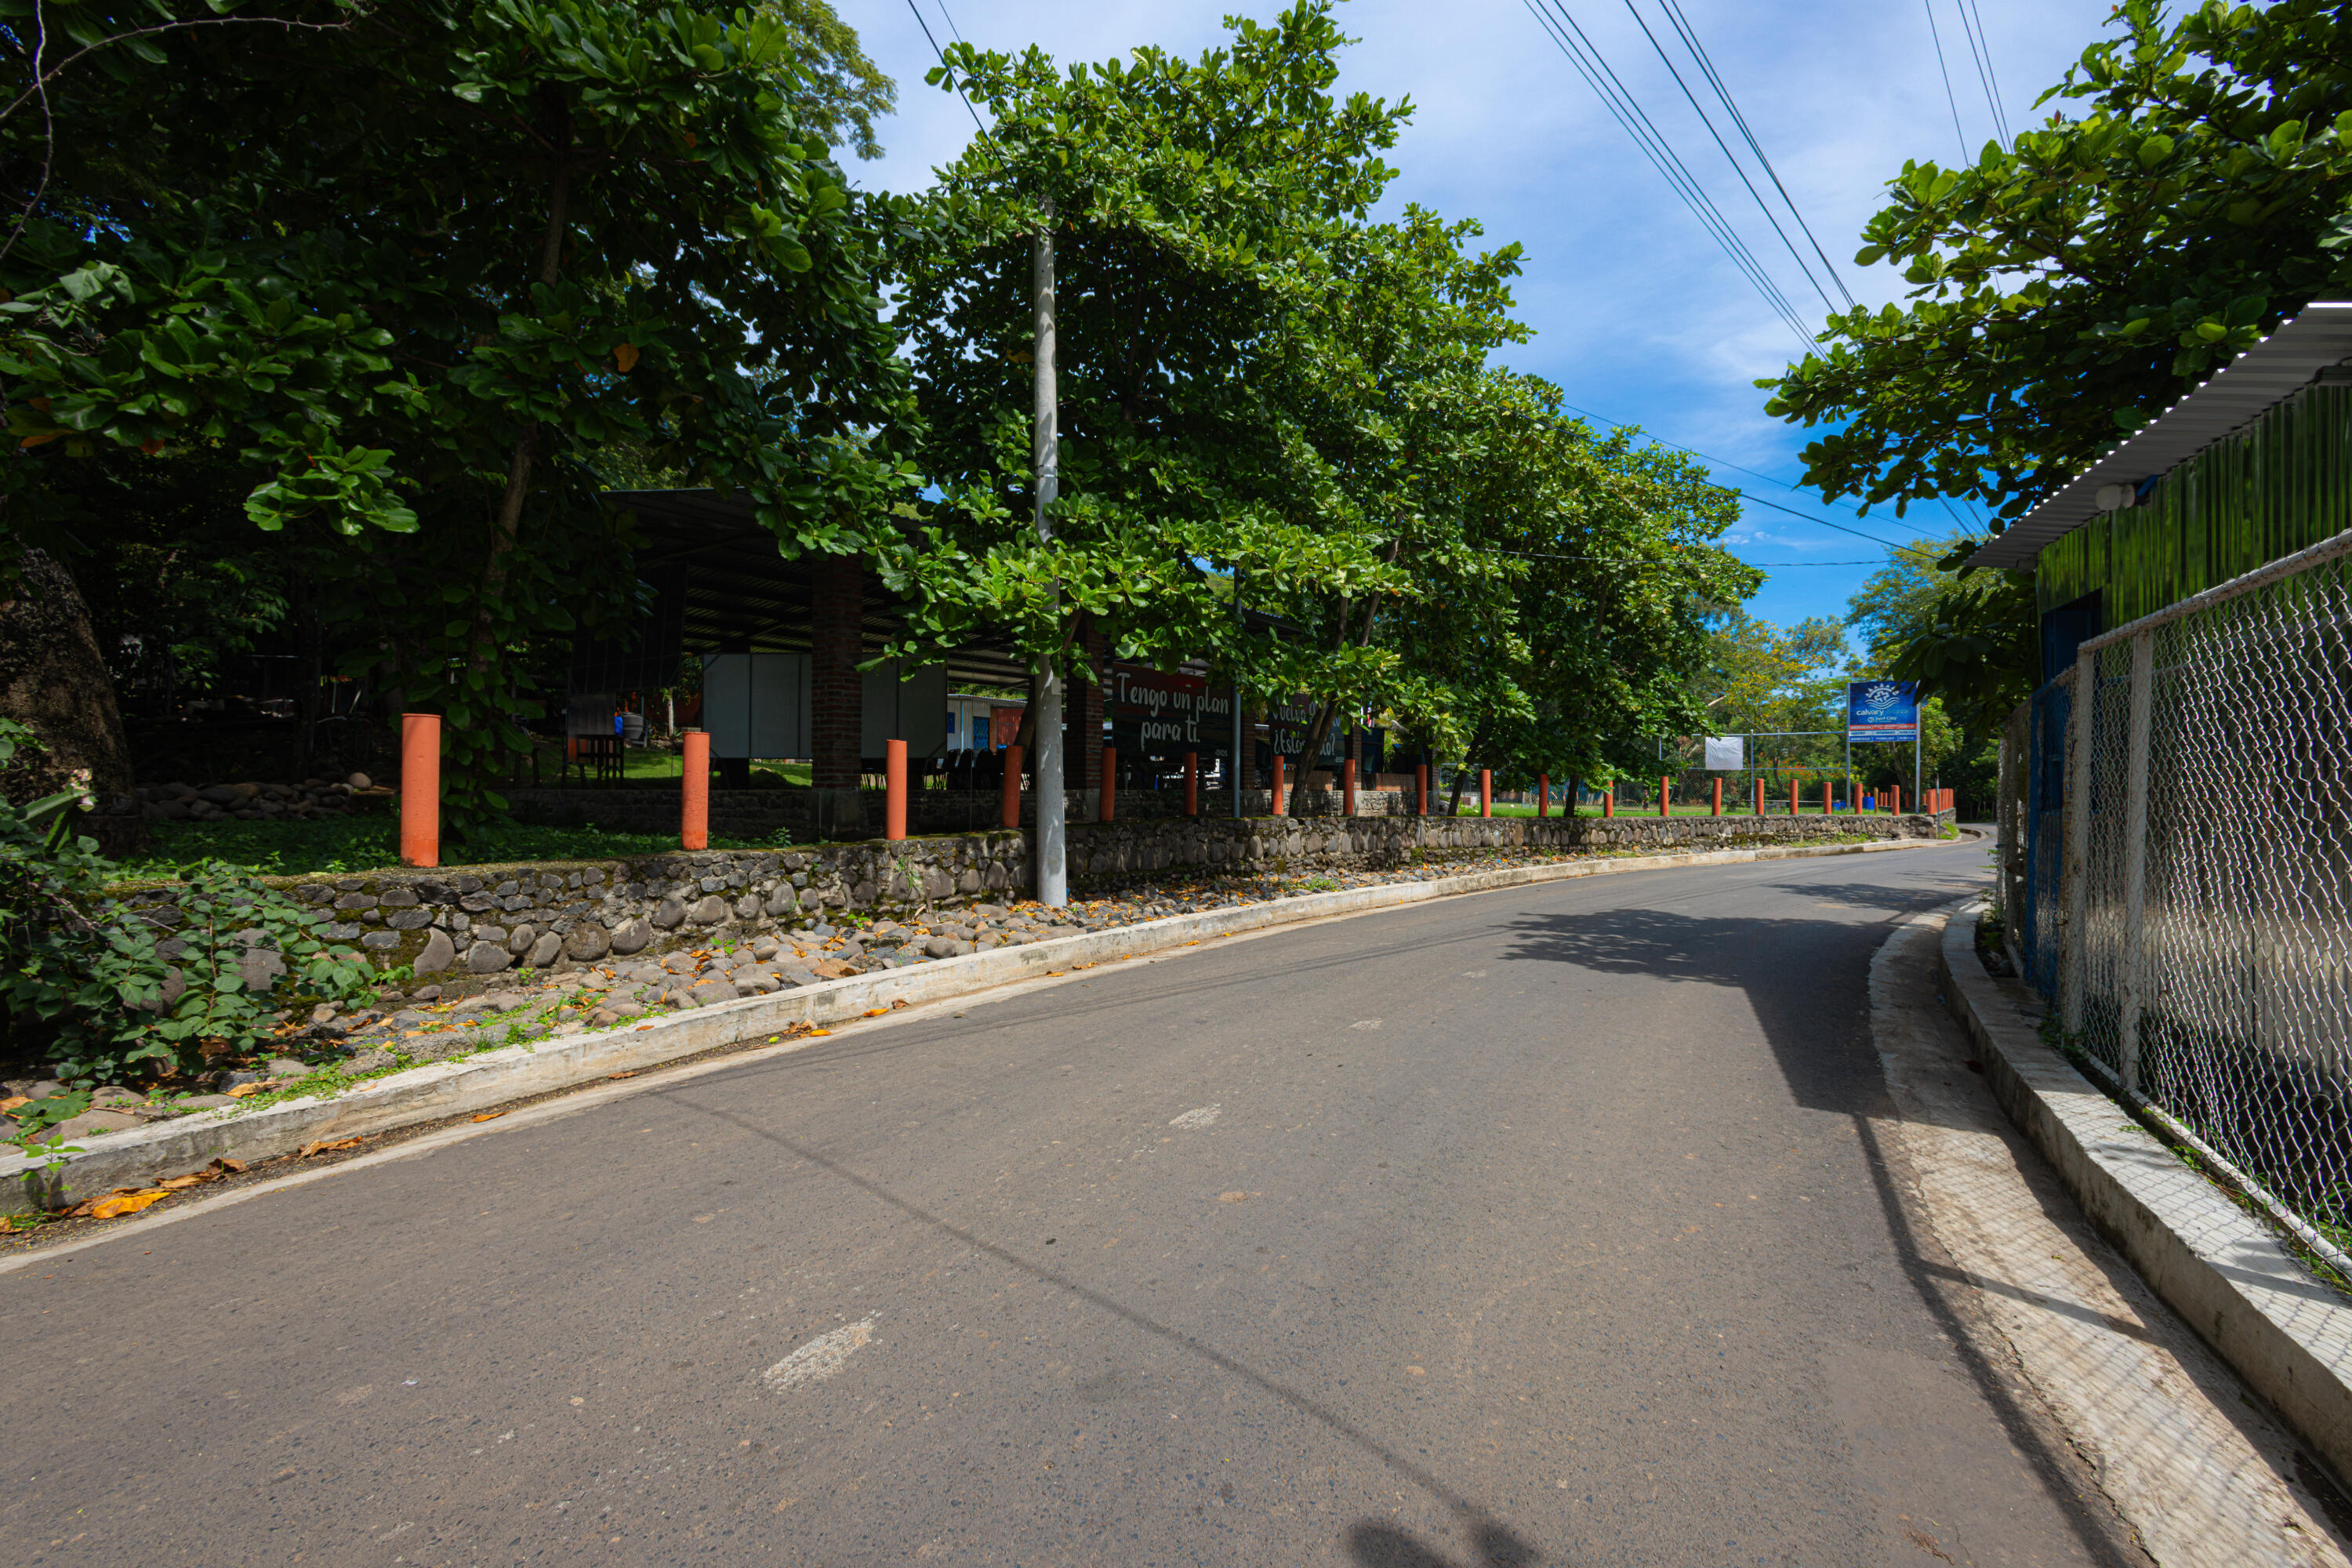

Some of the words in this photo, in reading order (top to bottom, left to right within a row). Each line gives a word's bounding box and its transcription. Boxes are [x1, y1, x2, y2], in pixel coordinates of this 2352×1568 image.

[1116, 672, 1167, 718] Tengo
[1173, 691, 1191, 710] un
[1196, 684, 1229, 723] plan
[1141, 720, 1181, 753] para
[1185, 713, 1201, 742] ti.
